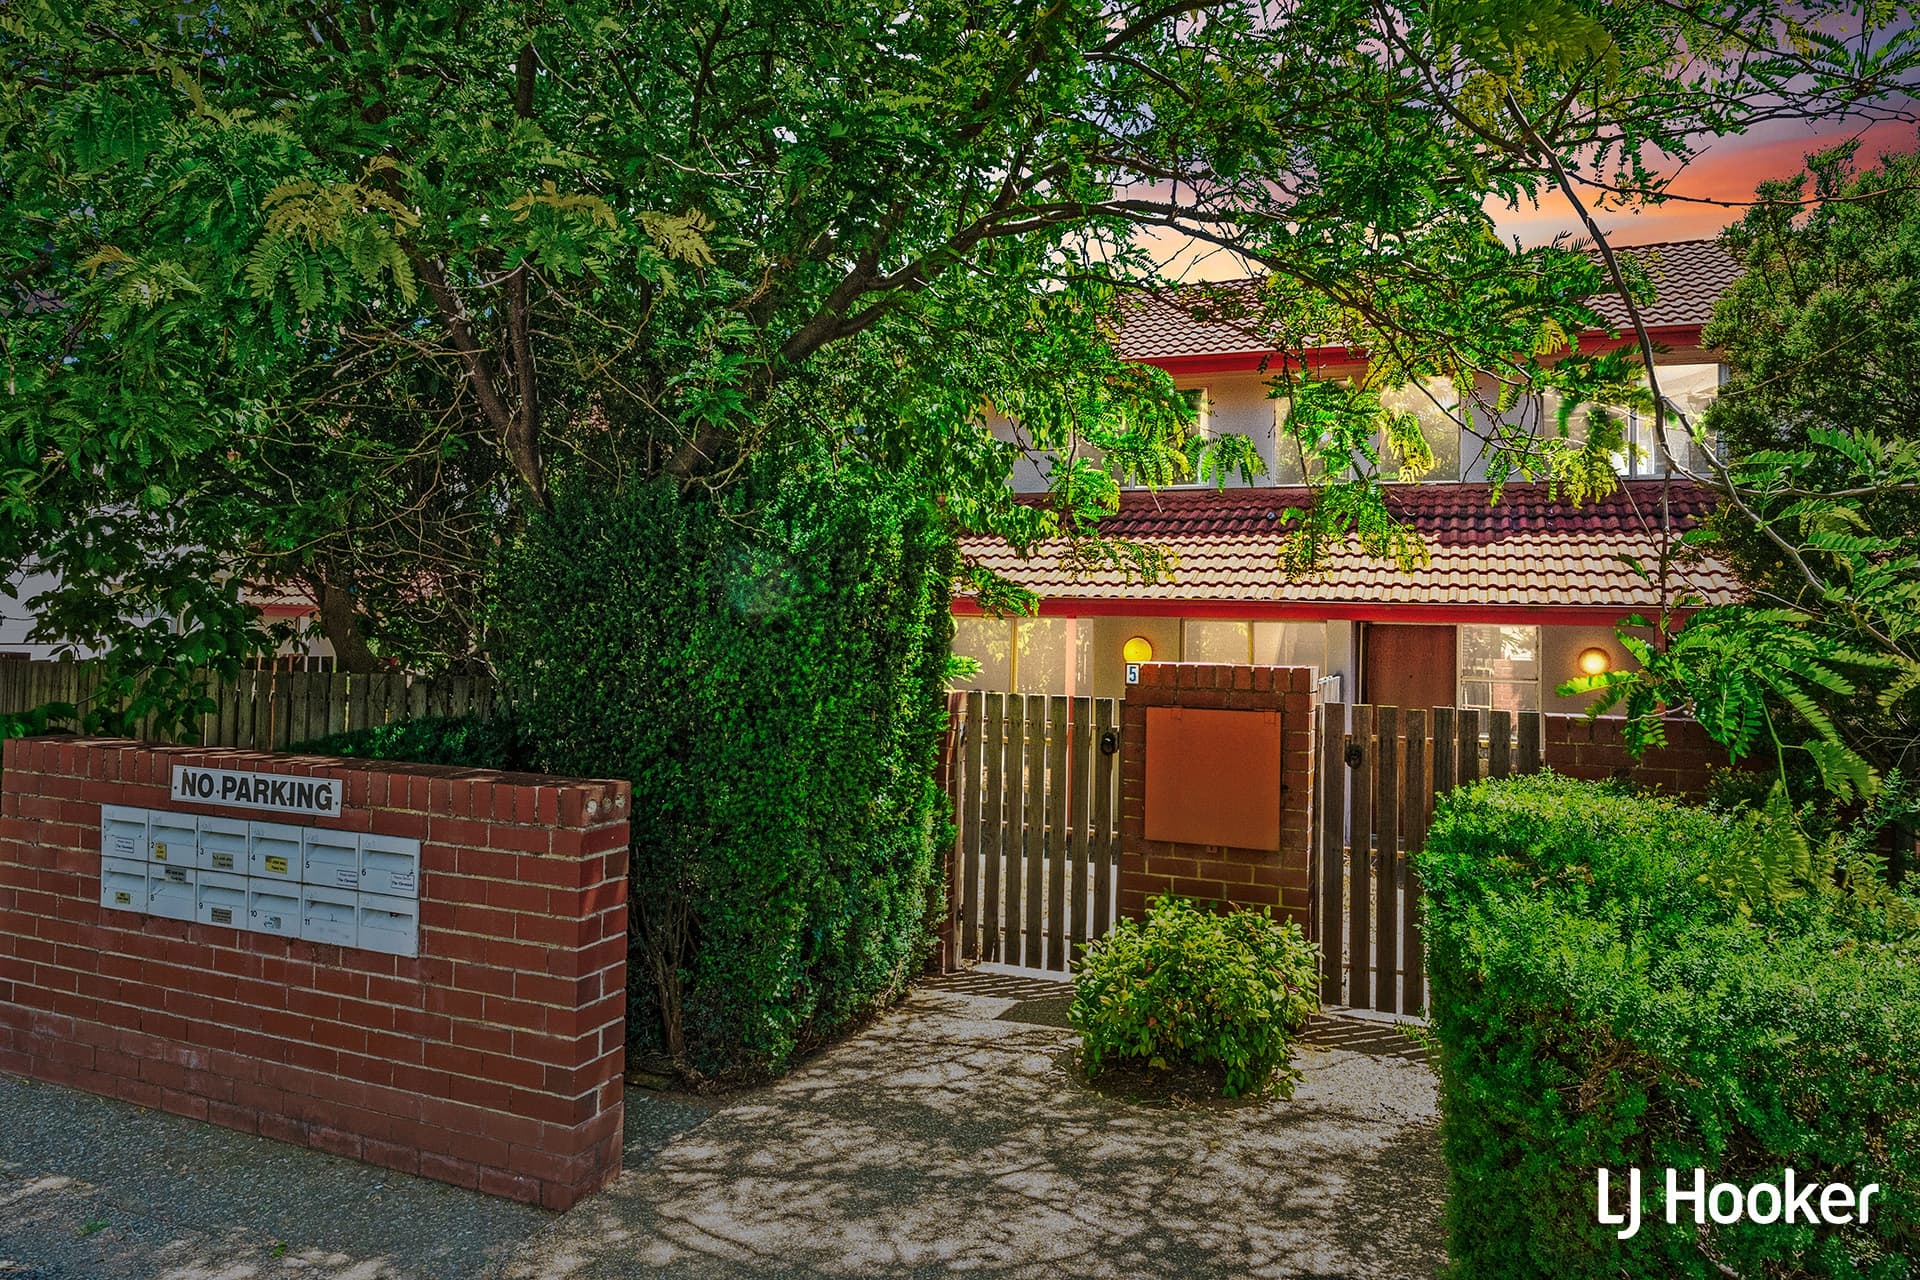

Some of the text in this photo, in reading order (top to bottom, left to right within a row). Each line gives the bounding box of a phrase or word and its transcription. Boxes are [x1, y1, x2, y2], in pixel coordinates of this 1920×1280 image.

[1129, 666, 1137, 682] 5
[181, 771, 333, 811] NO PARKING
